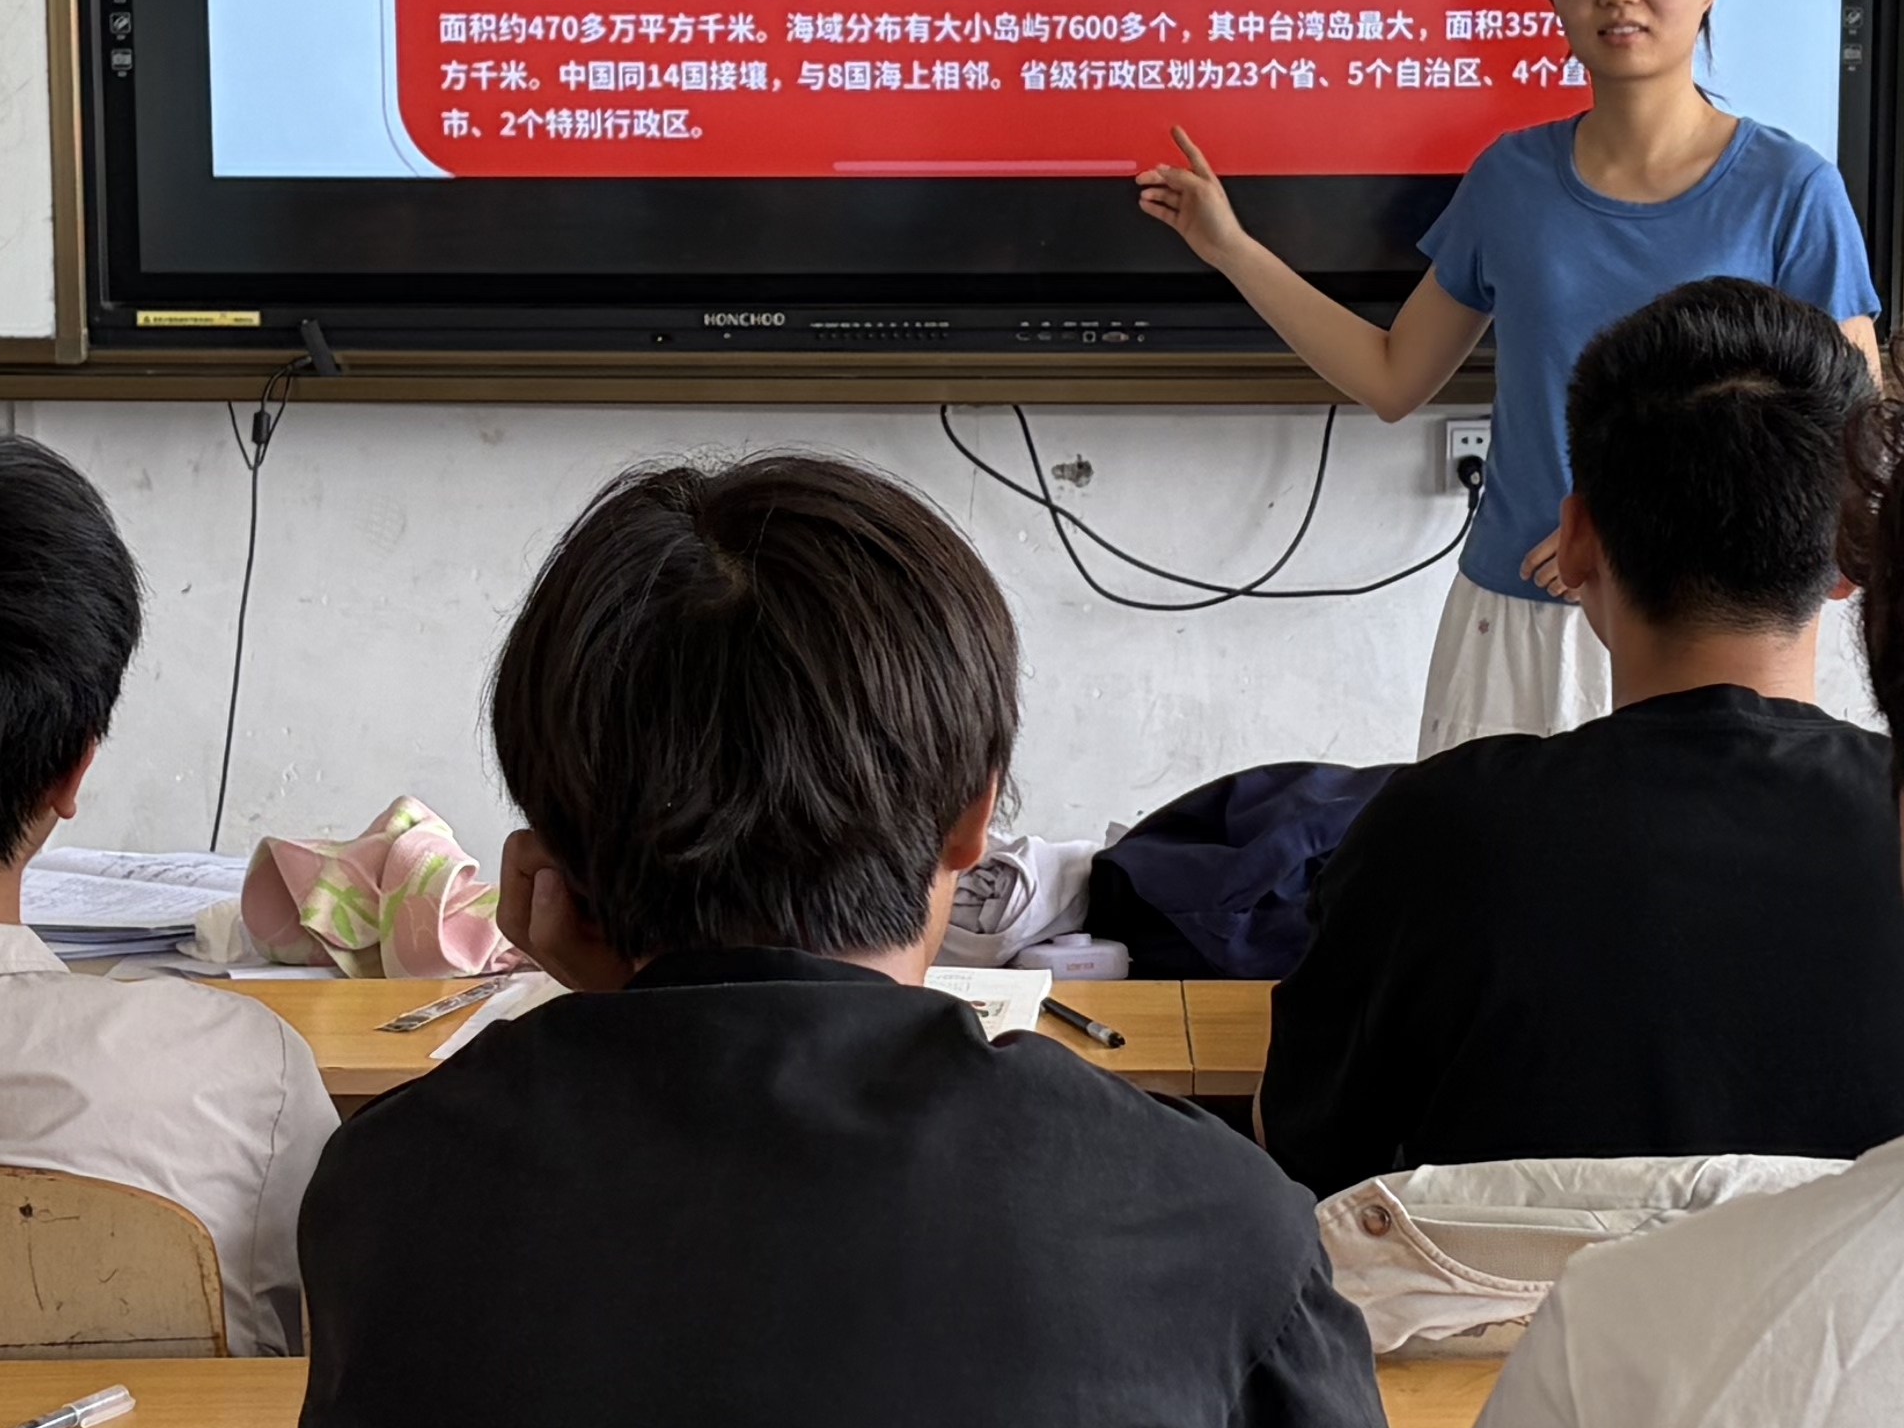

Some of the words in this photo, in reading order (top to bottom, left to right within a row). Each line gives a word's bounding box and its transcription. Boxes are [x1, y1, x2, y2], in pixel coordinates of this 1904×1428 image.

[441, 107, 703, 140] 市、2个特别行政区。
